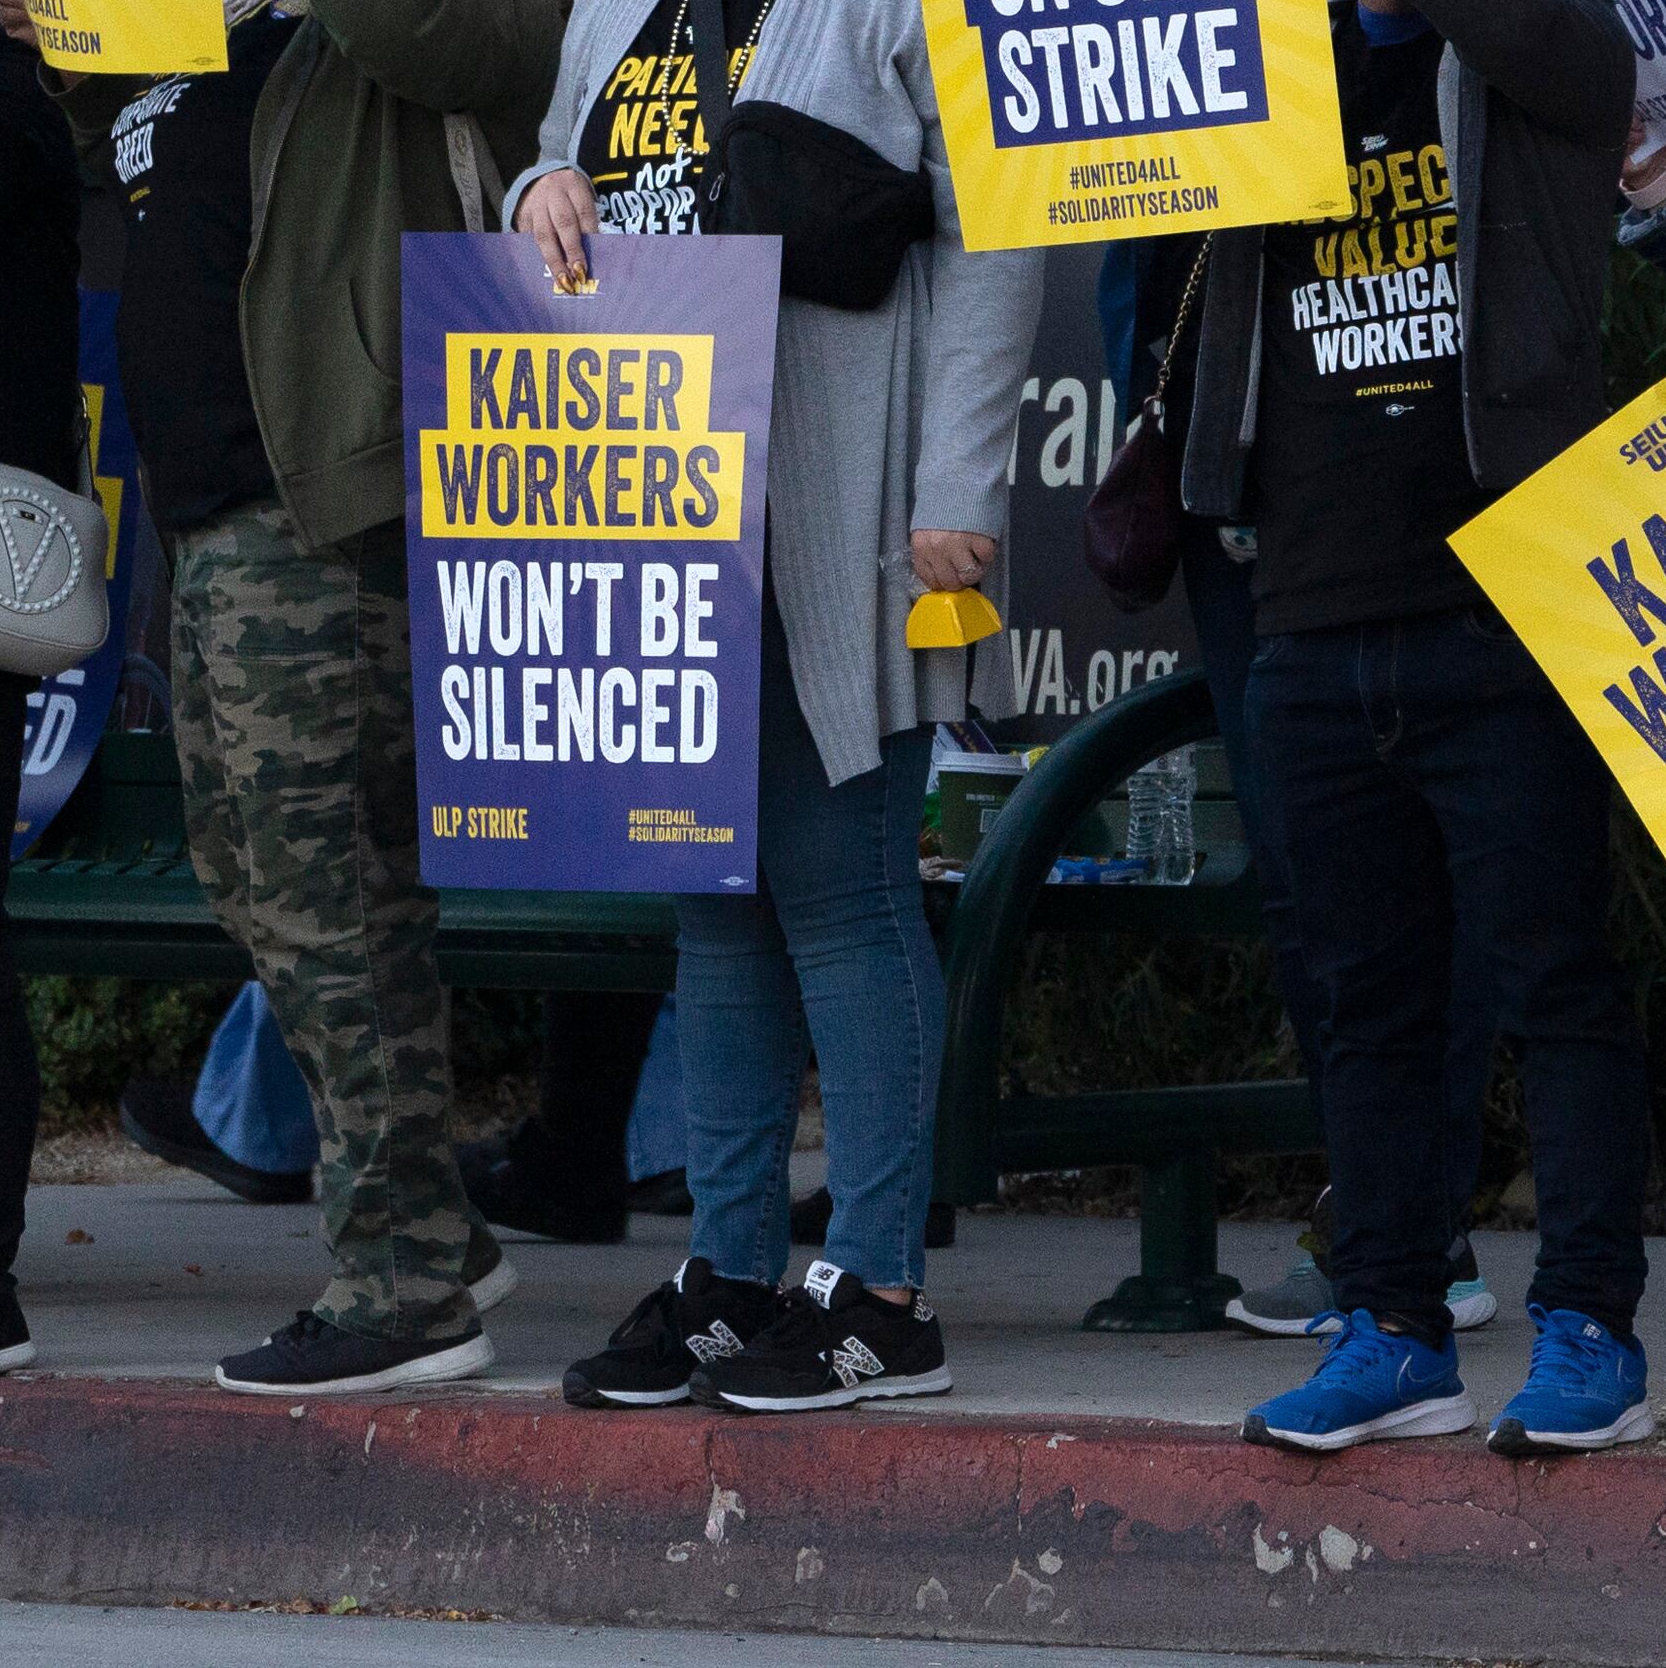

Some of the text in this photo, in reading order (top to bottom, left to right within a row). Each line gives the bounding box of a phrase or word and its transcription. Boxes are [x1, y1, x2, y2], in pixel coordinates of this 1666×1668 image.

[999, 9, 1247, 133] STRIKE
[635, 147, 692, 192] not
[1070, 159, 1180, 191] #UNITED4ALL
[1048, 185, 1219, 226] #SOLIDARITYSEASON
[1315, 214, 1458, 278] VALUE
[1292, 261, 1459, 330] HEALTHCA
[470, 348, 684, 432] KAISER
[1356, 379, 1434, 397] #UNITED4ALL
[436, 442, 720, 529] WORKERS
[437, 560, 719, 659] WON'T BE
[442, 666, 719, 765] SILENCED
[433, 806, 529, 840] ULP STRIKE
[629, 810, 697, 826] #UNITED4ALL
[629, 826, 734, 843] #SOLIDARITYSEASON
